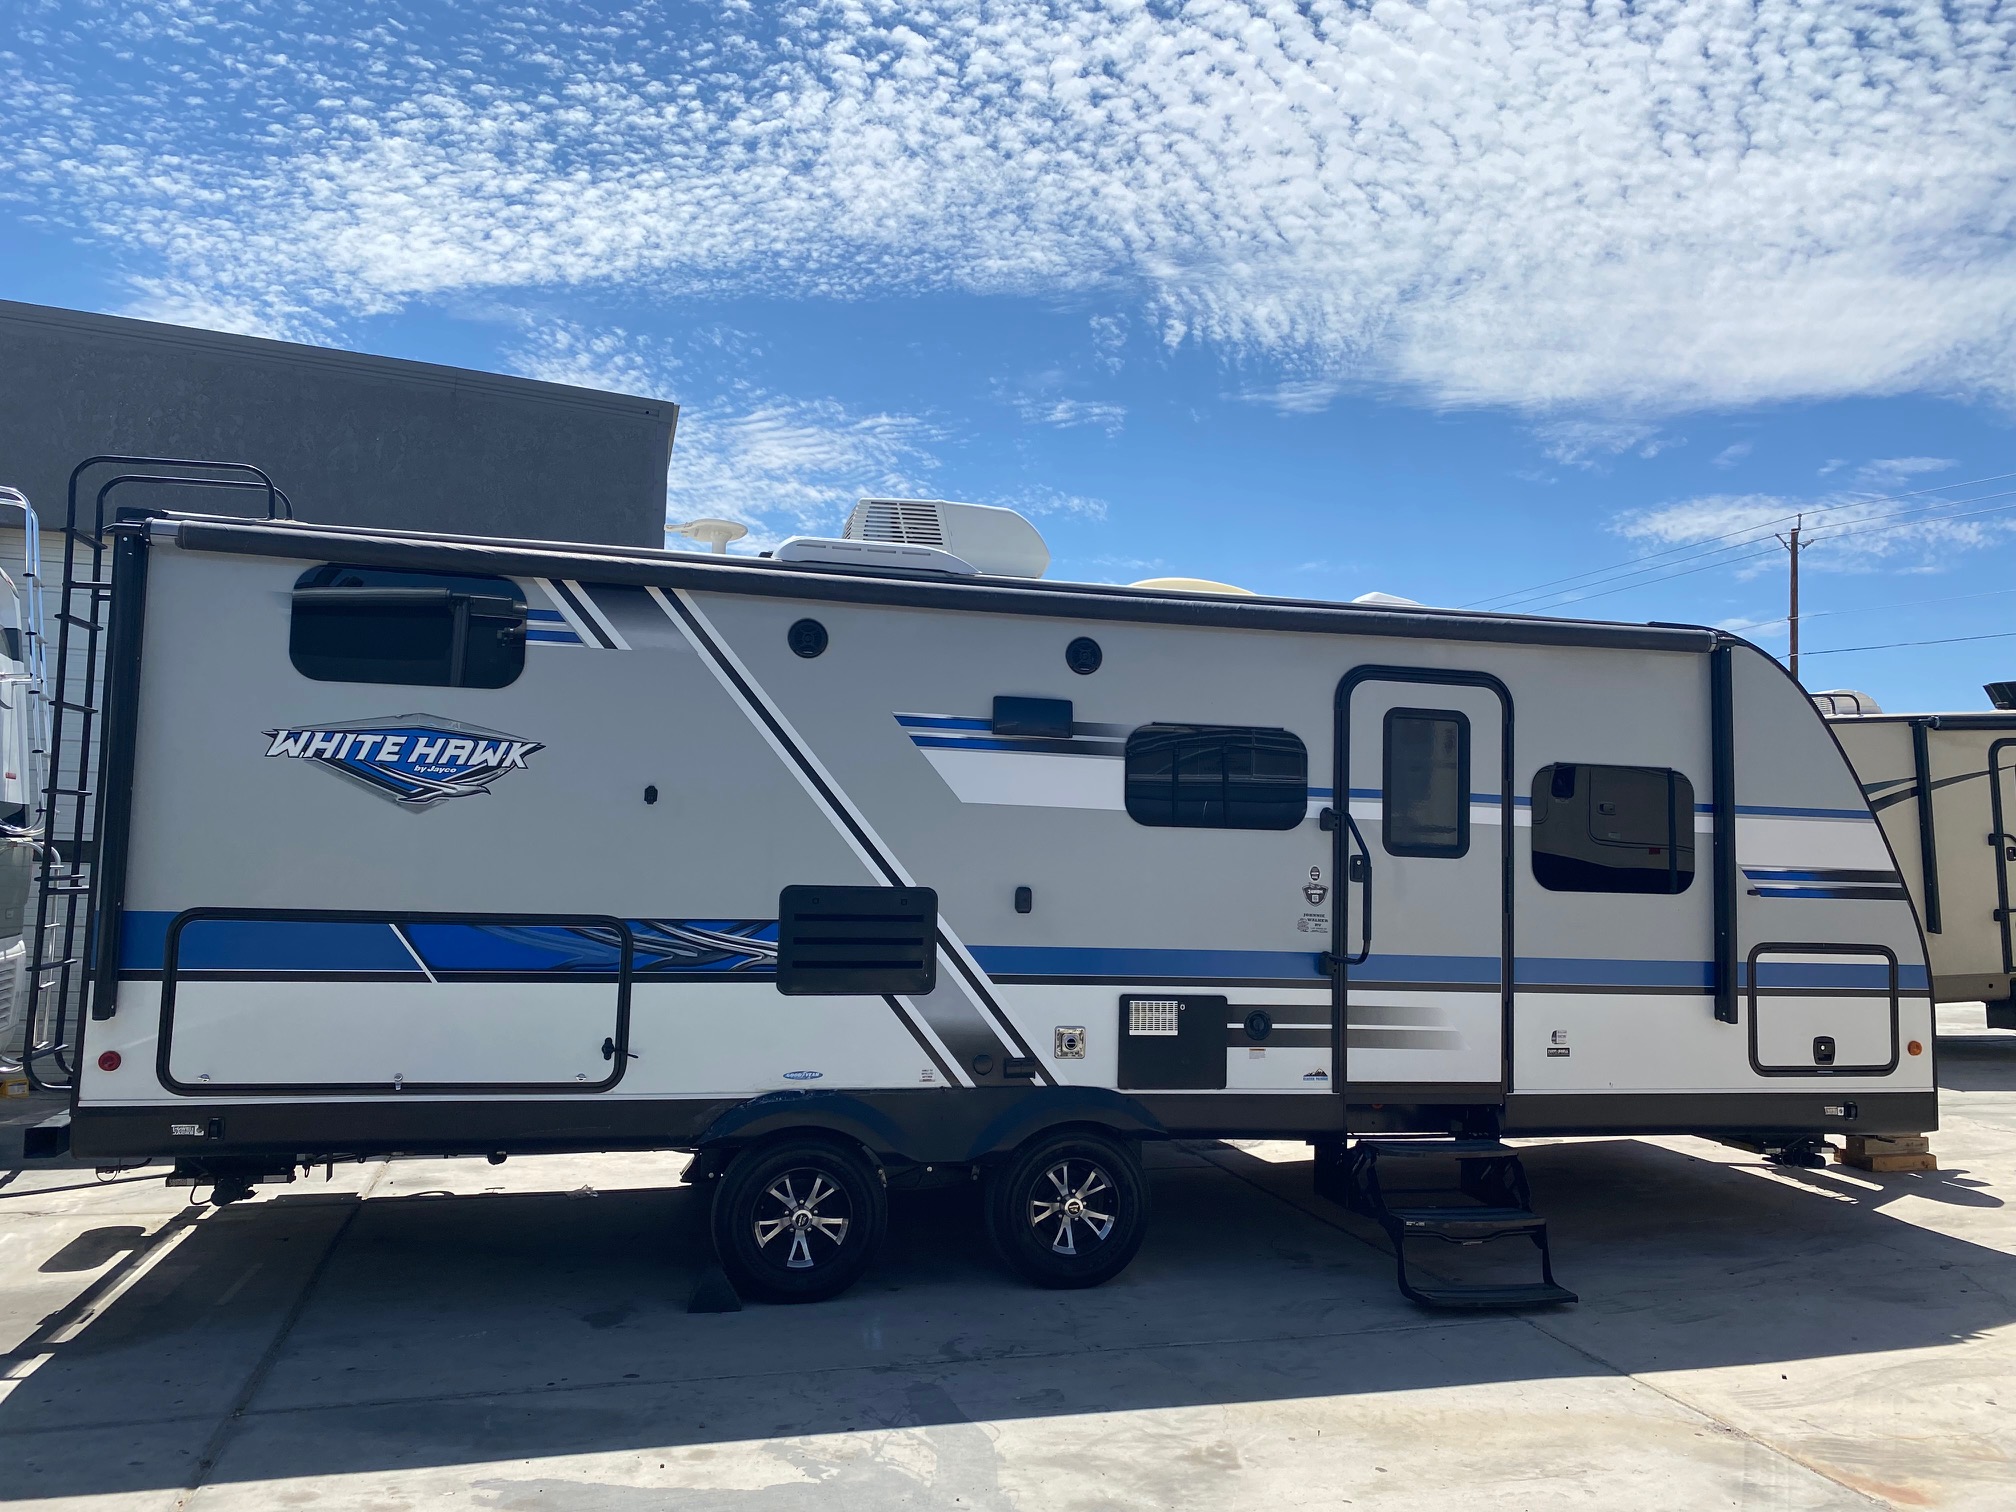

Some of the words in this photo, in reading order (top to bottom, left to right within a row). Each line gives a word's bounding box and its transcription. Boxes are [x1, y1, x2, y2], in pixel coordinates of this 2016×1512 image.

[264, 729, 408, 763] WHITE
[406, 737, 542, 769] HAWK
[413, 764, 427, 773] by
[427, 765, 457, 774] Jayco
